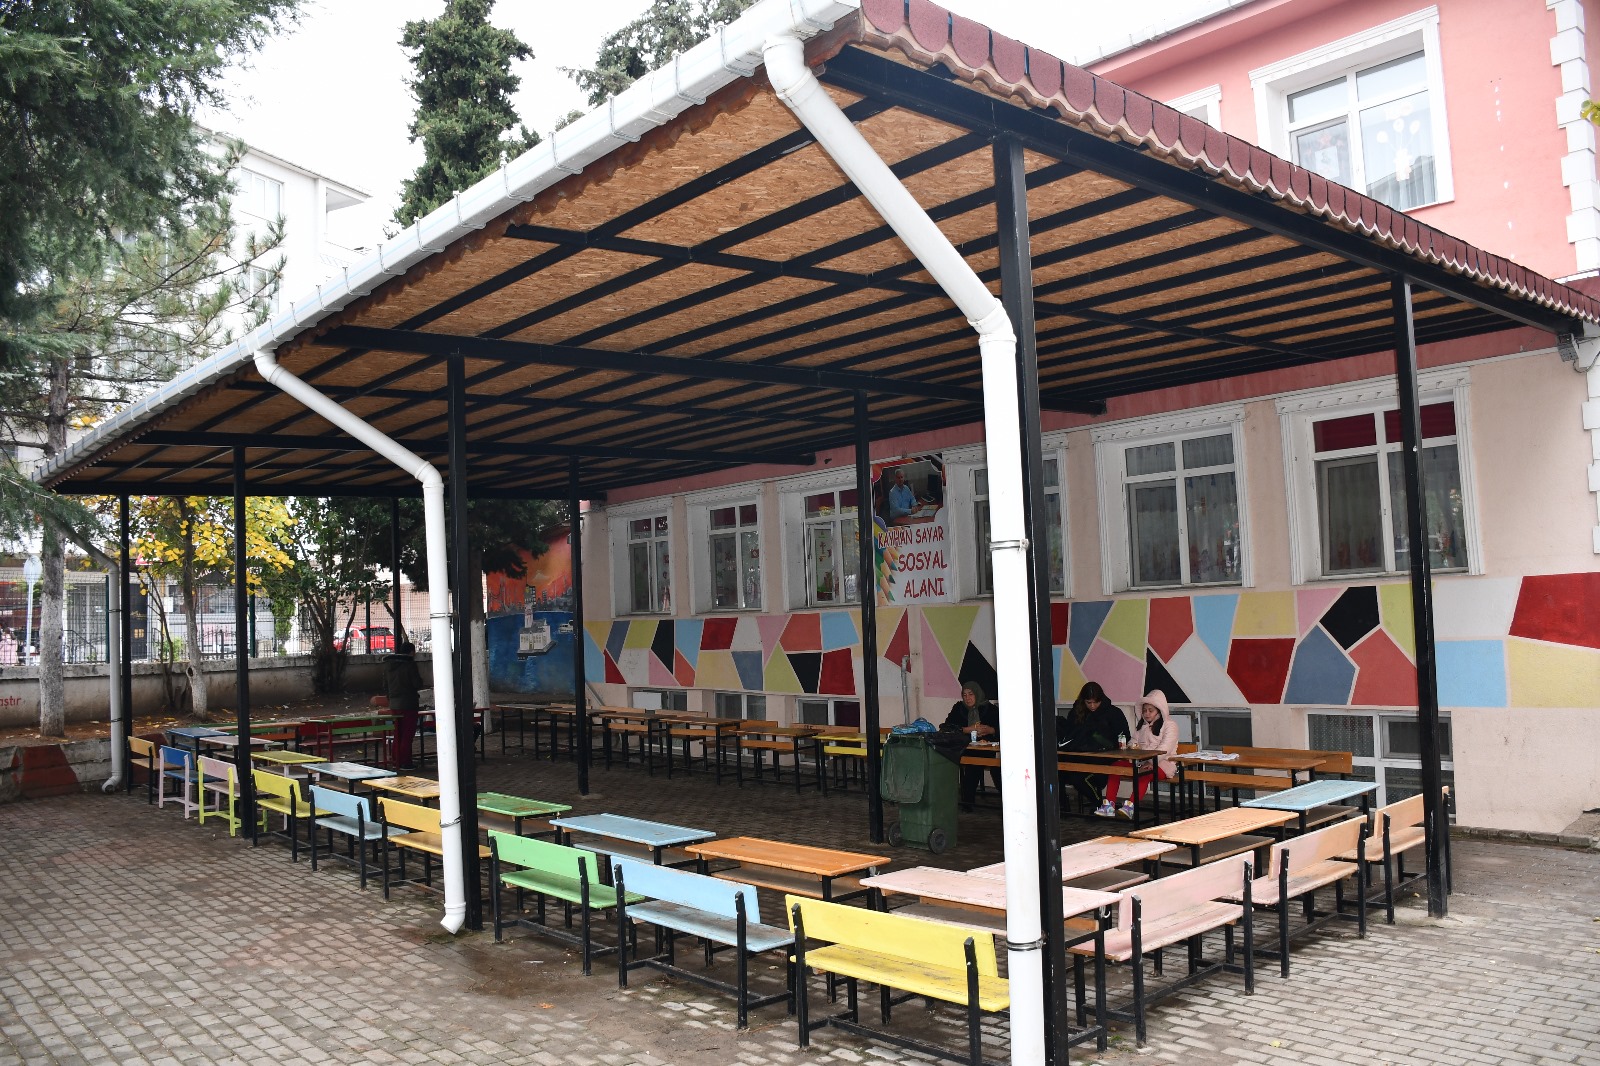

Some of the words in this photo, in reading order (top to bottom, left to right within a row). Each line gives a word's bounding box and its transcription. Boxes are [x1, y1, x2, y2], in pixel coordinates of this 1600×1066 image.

[878, 529, 913, 548] KAYHAN
[916, 525, 944, 544] SAYAR
[898, 549, 948, 572] SOSYAL
[904, 577, 945, 598] ALANI
